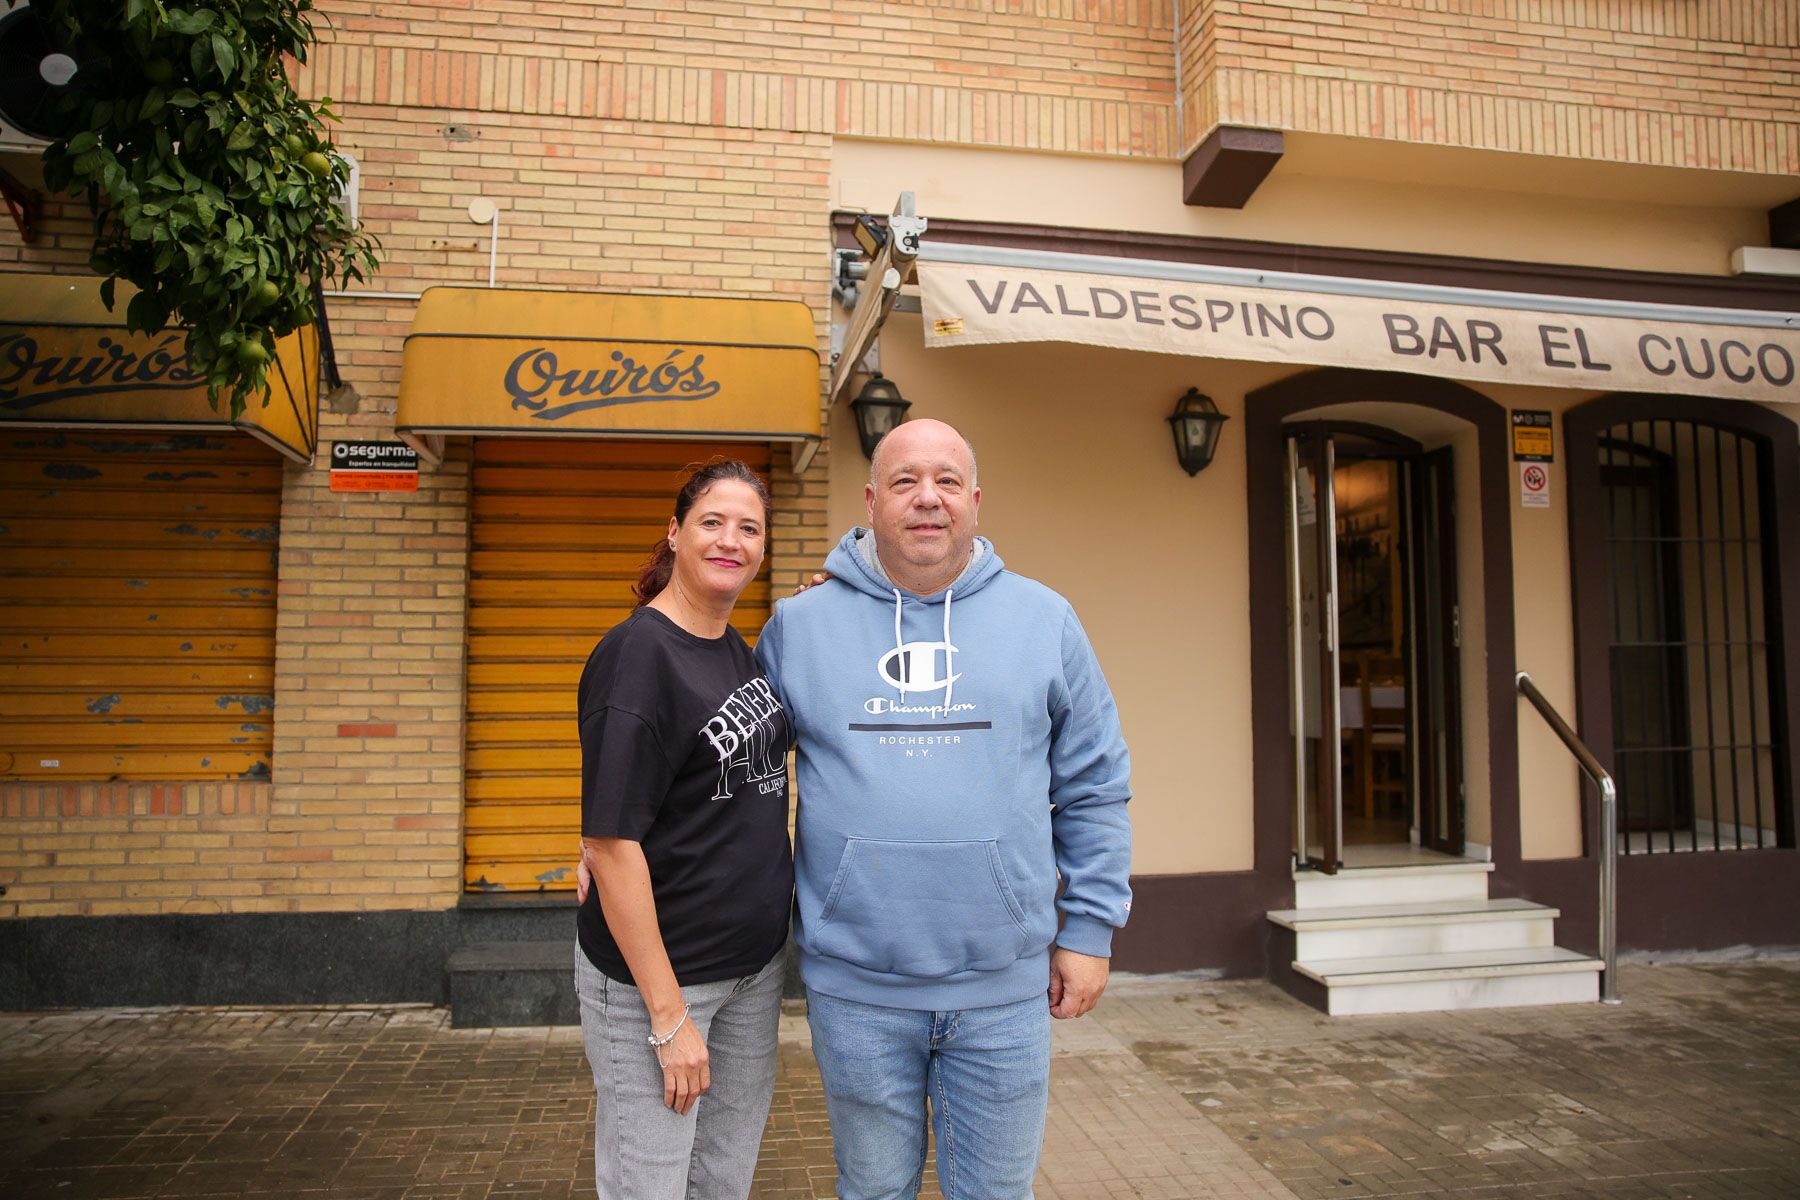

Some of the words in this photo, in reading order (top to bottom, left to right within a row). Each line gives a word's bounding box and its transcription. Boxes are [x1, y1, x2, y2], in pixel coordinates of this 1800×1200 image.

[966, 279, 1335, 341] VALDESPINO
[1382, 313, 1507, 366] BAR
[1538, 324, 1612, 372] EL
[1638, 333, 1796, 387] CUCO
[503, 347, 721, 420] Quirós
[349, 445, 416, 459] segurma
[698, 676, 784, 762] BEVER
[864, 697, 976, 719] Champon
[879, 735, 961, 745] ROCHESTER
